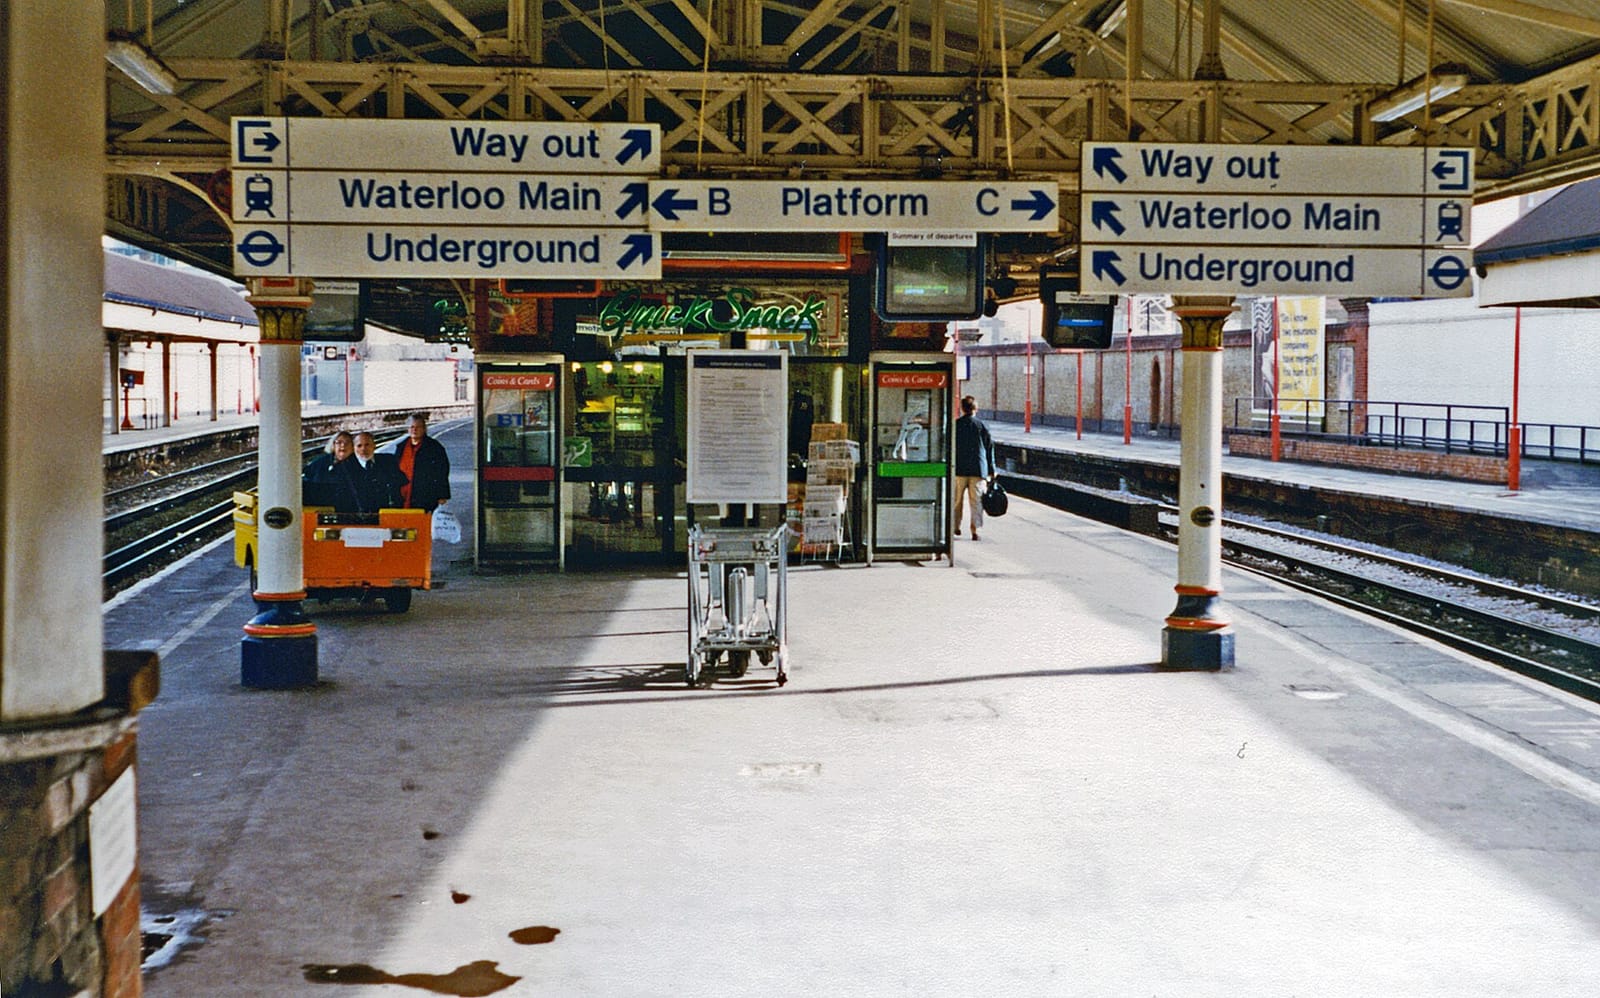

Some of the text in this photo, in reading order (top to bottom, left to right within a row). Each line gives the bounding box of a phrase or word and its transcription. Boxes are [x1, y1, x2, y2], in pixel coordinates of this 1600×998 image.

[450, 126, 601, 163] Way out
[1141, 148, 1281, 184] Way out
[338, 178, 602, 212] Waterloo Main
[708, 186, 1000, 217] B Platform C
[1139, 200, 1381, 232] Waterloo Main
[367, 232, 601, 268] Underground
[1139, 252, 1355, 288] Underground
[599, 287, 826, 345] Quick Snack
[486, 376, 540, 385] Coins & Cards
[881, 375, 933, 384] Coins & Cards
[497, 414, 525, 426] BT
